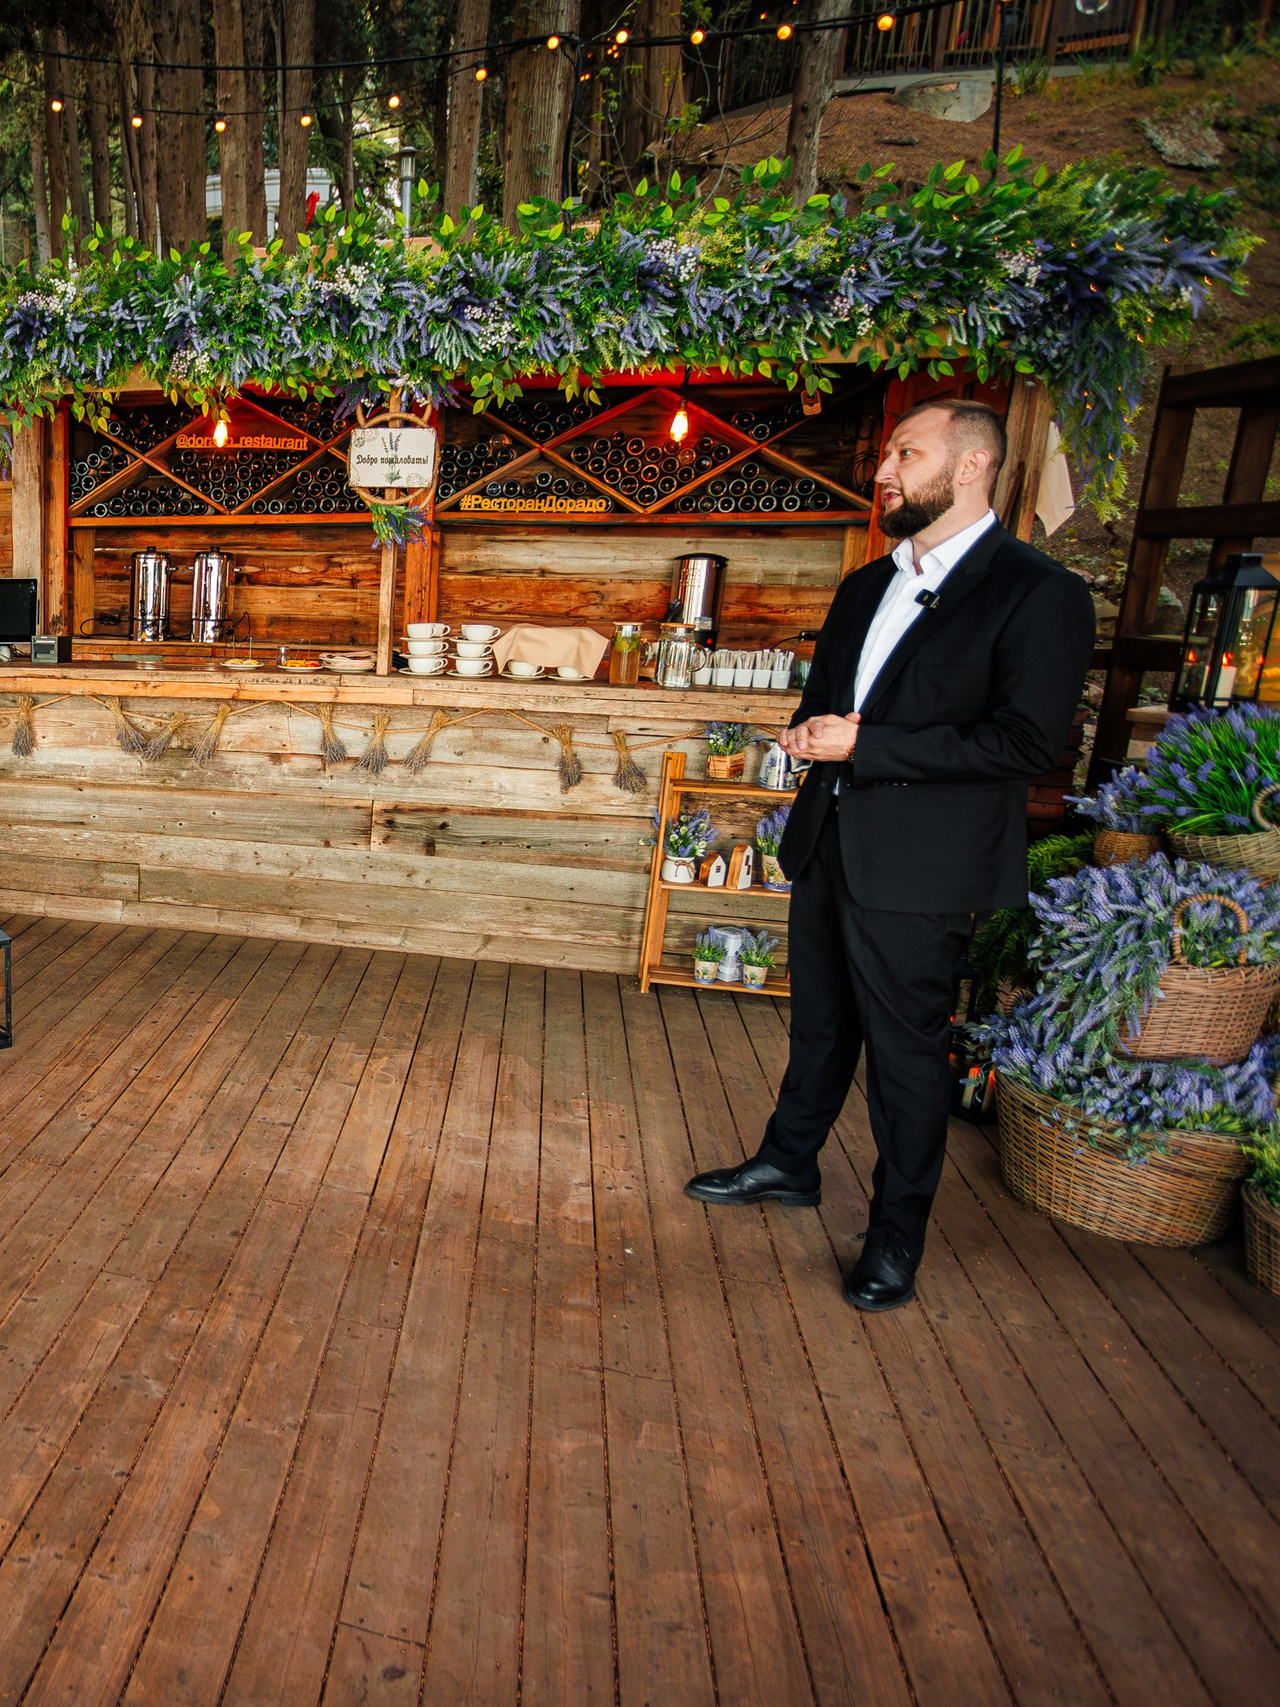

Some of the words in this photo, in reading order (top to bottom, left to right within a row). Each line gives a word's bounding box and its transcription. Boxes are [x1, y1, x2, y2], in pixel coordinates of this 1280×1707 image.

[175, 433, 308, 450] @dorao_restaurant
[356, 454, 378, 466] Добро
[460, 494, 607, 513] #РесторанДорадо
